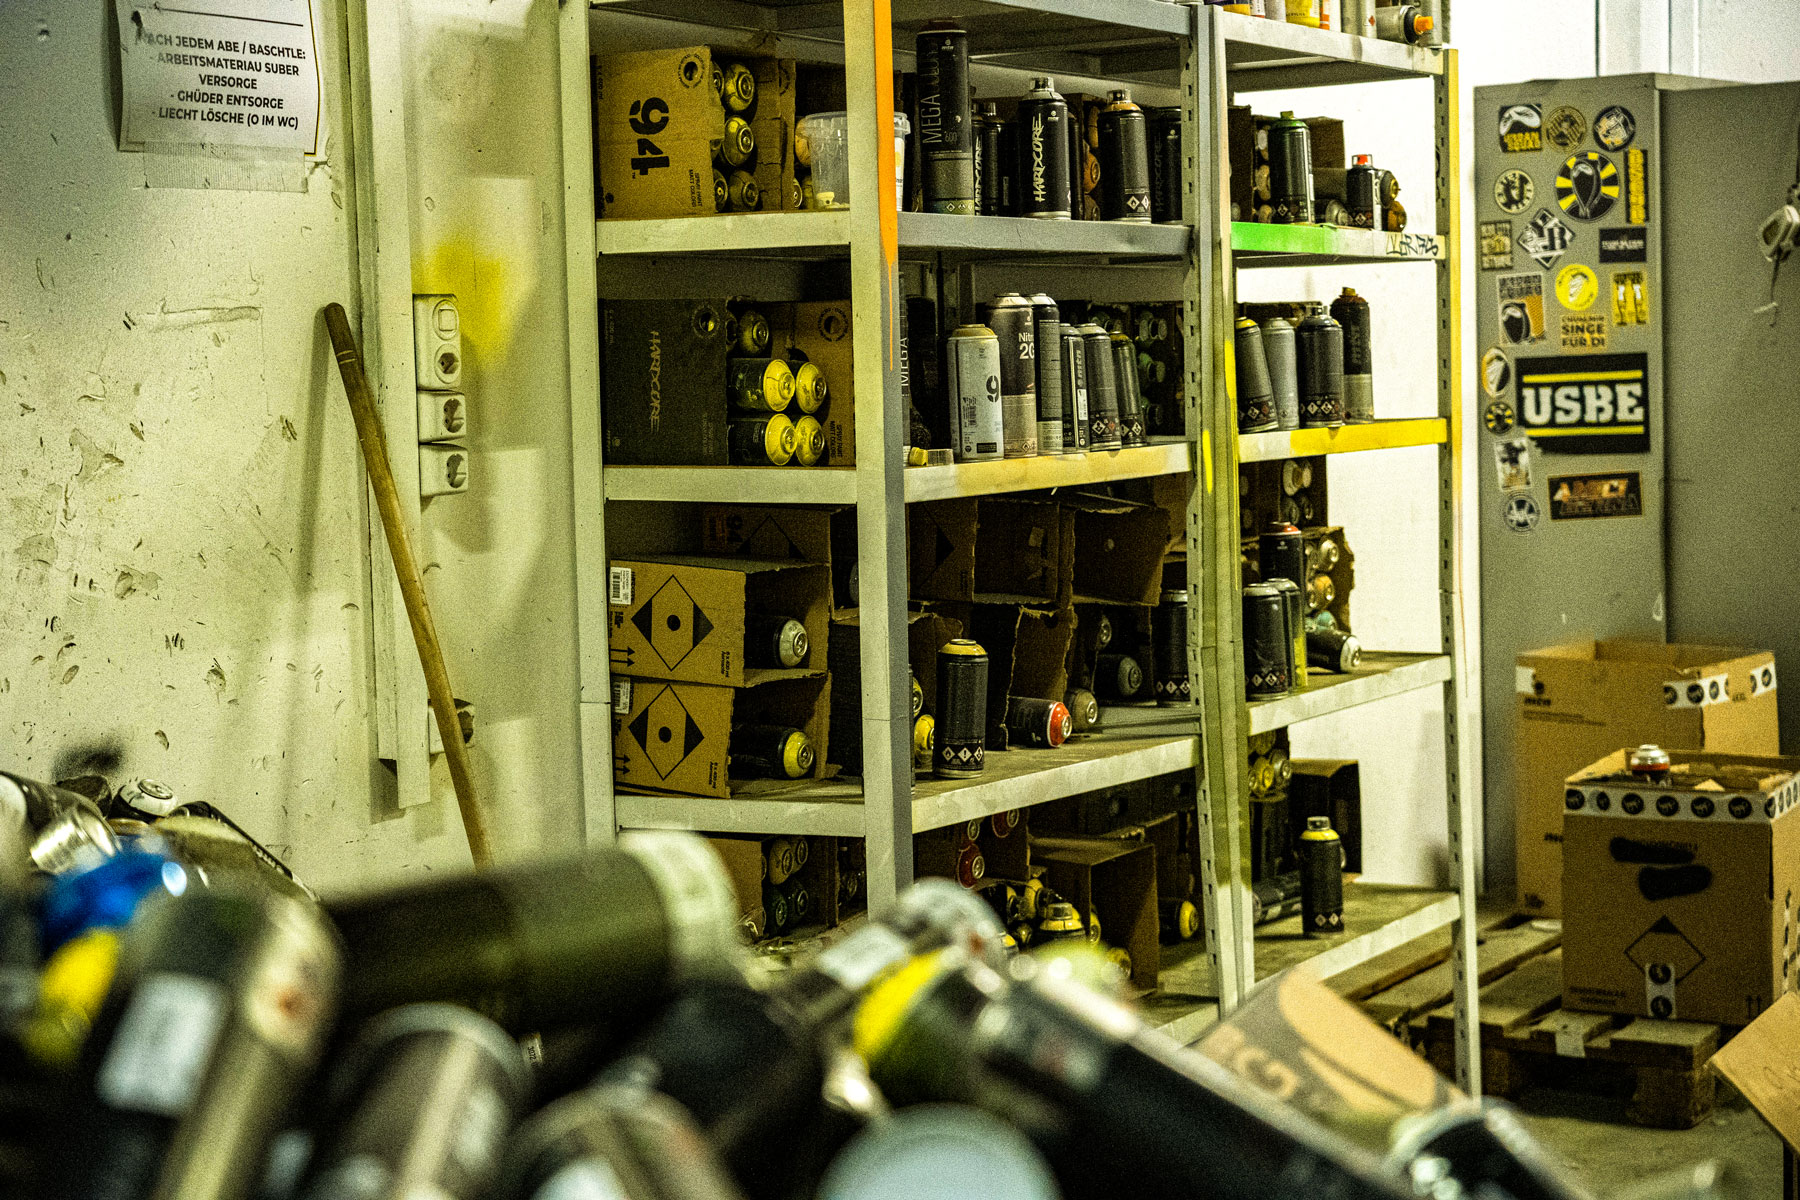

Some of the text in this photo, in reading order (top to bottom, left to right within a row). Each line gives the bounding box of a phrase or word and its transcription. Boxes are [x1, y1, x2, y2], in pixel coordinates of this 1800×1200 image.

[135, 33, 172, 46] ACH
[176, 34, 214, 50] JEDEM
[217, 42, 240, 53] ABE
[249, 44, 306, 60] BASCHTLE:
[158, 53, 262, 72] ARBEITSMATERIAU
[264, 62, 300, 76] SUBER
[199, 74, 258, 90] VERSORGE
[177, 88, 224, 105] GHÜDER
[226, 94, 284, 110] ENTSORGE
[159, 107, 198, 121] LIECHT
[200, 108, 244, 124] LÖSCHE
[262, 115, 274, 126] IM
[277, 116, 298, 130] WC)
[629, 97, 670, 176] 94
[1032, 112, 1046, 203] HARDCORE
[650, 330, 661, 434] HARDCORE
[1522, 383, 1644, 424] USBE
